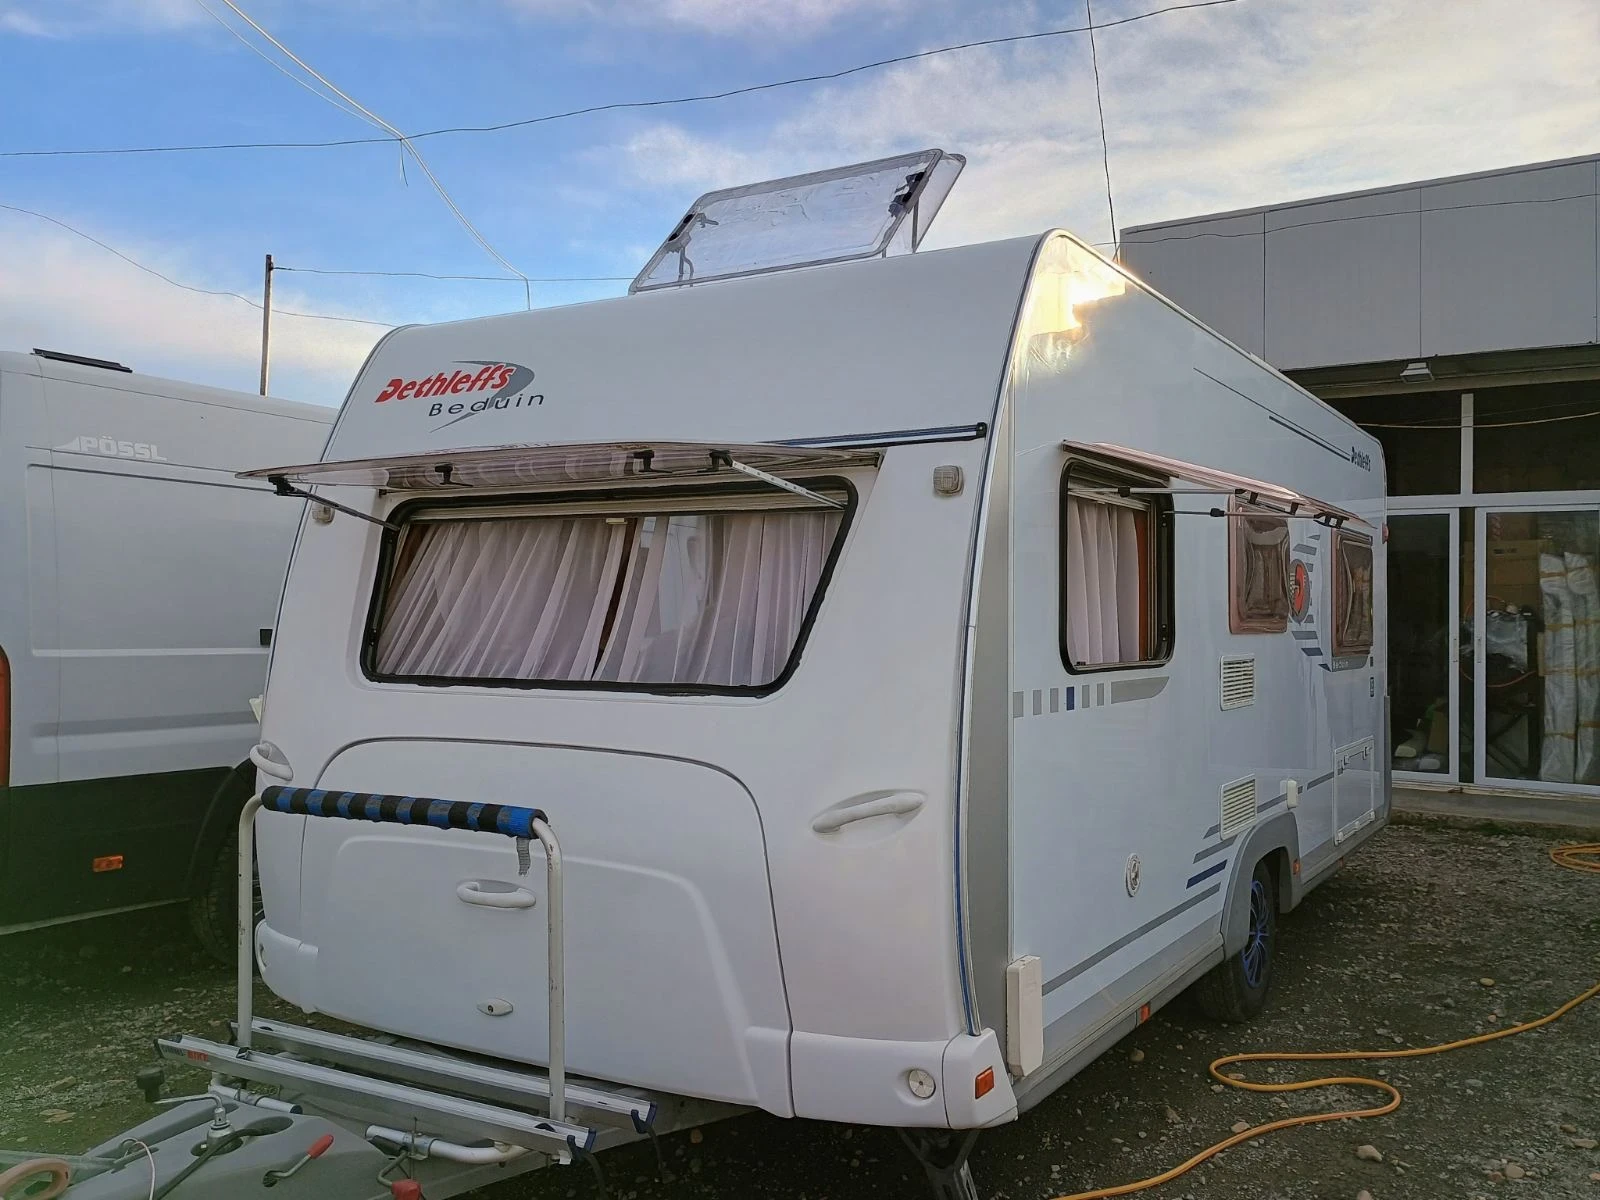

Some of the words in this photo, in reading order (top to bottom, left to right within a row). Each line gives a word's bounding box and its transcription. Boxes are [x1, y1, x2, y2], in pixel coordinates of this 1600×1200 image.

[374, 363, 516, 403] Dethleffs
[428, 393, 545, 417] Beduin
[79, 434, 168, 461] PÖSSL
